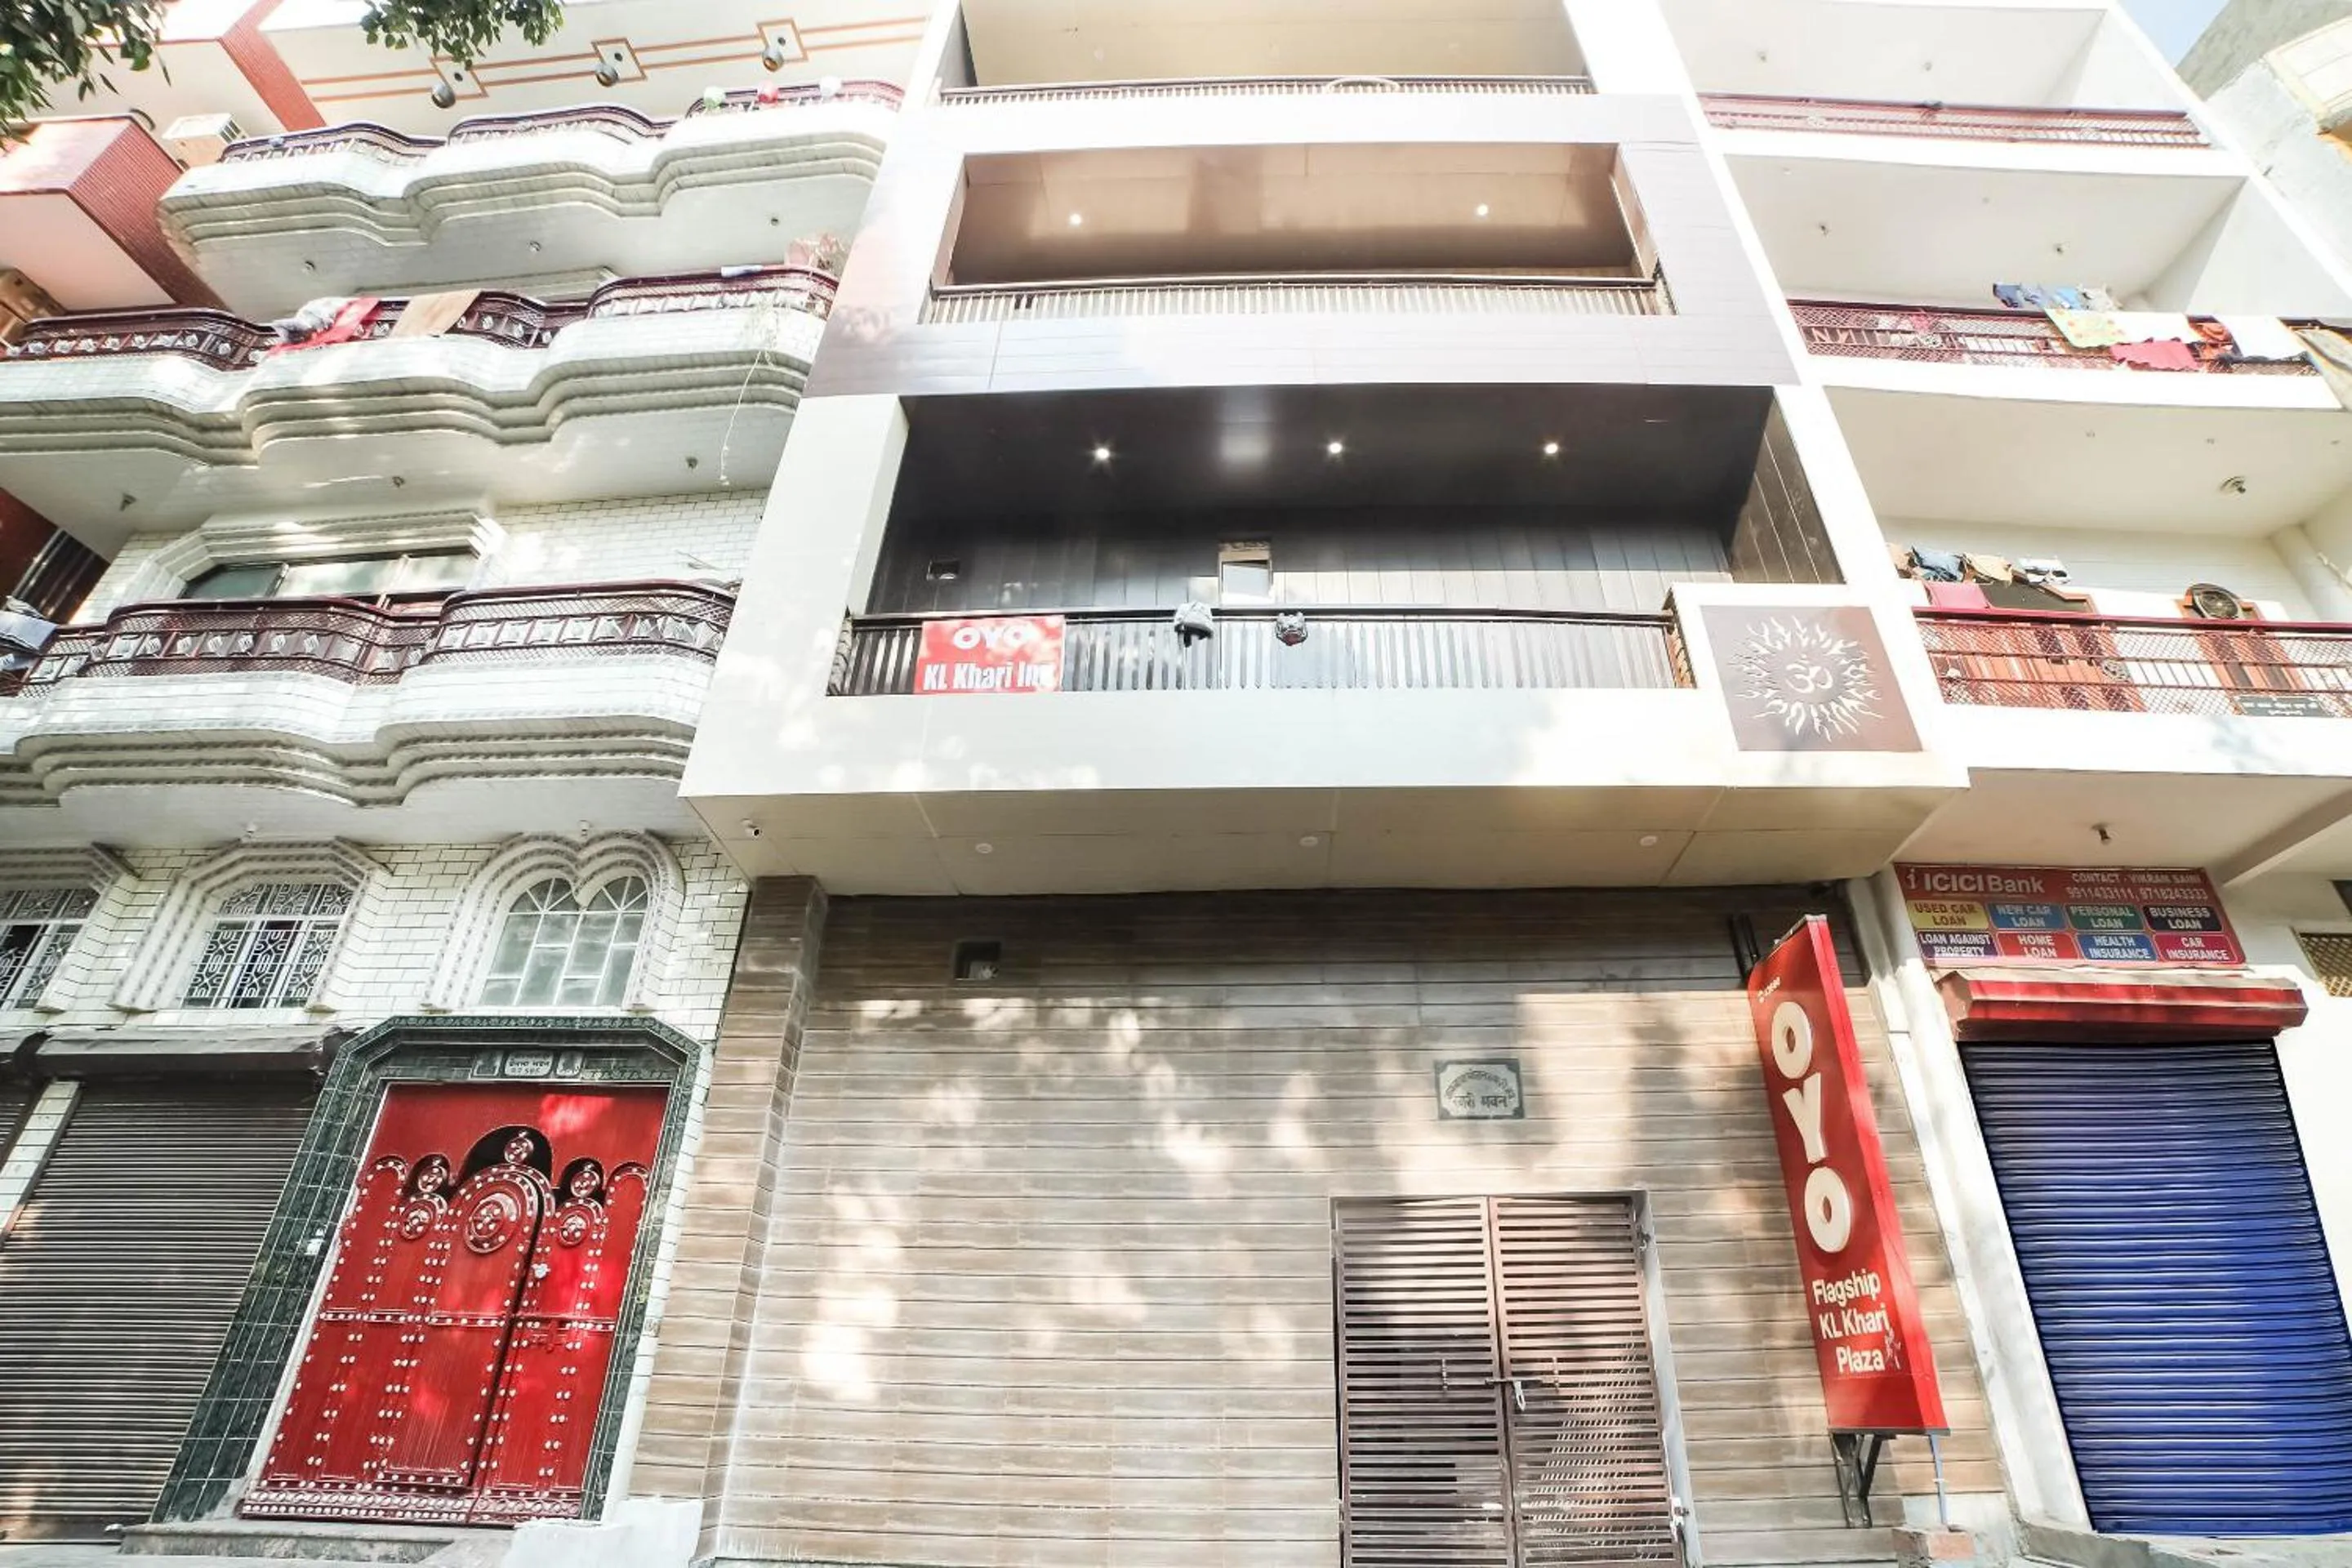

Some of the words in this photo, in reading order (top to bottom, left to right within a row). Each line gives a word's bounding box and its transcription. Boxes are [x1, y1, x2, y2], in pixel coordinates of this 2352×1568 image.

[953, 625, 1030, 650] OYO
[923, 662, 948, 690] KL
[952, 661, 1013, 690] Khari
[1923, 871, 1984, 893] ICICI
[1986, 875, 2046, 893] Bank
[2071, 871, 2120, 884] CONTACT
[1914, 902, 1948, 913] USED
[1950, 903, 1977, 914] CAR
[1995, 904, 2025, 915] NEW
[2025, 904, 2052, 915] CAR
[2069, 905, 2135, 917] PERSONAL
[2149, 906, 2211, 918] BUSINESS
[1932, 915, 1967, 926] LOAN
[2011, 916, 2046, 928] LOAN
[2090, 918, 2124, 929] LOAN
[2167, 919, 2203, 929] LOAN
[1919, 933, 1947, 944] LOAN
[1949, 933, 1991, 945] AGAINST
[2016, 934, 2055, 946] HOME
[2093, 935, 2136, 947] HEALTH
[2181, 938, 2205, 948] CAR
[1934, 946, 1984, 957] PROPERTY
[2023, 947, 2058, 959] LOAN
[2088, 947, 2152, 960] INSURANCE
[2167, 949, 2230, 960] INSURANCE
[1771, 1001, 1851, 1254] OYO
[1811, 1267, 1882, 1307] Flagship
[1818, 1311, 1844, 1340] KL
[1841, 1301, 1891, 1337] Khari
[1835, 1345, 1886, 1374] Plaza
